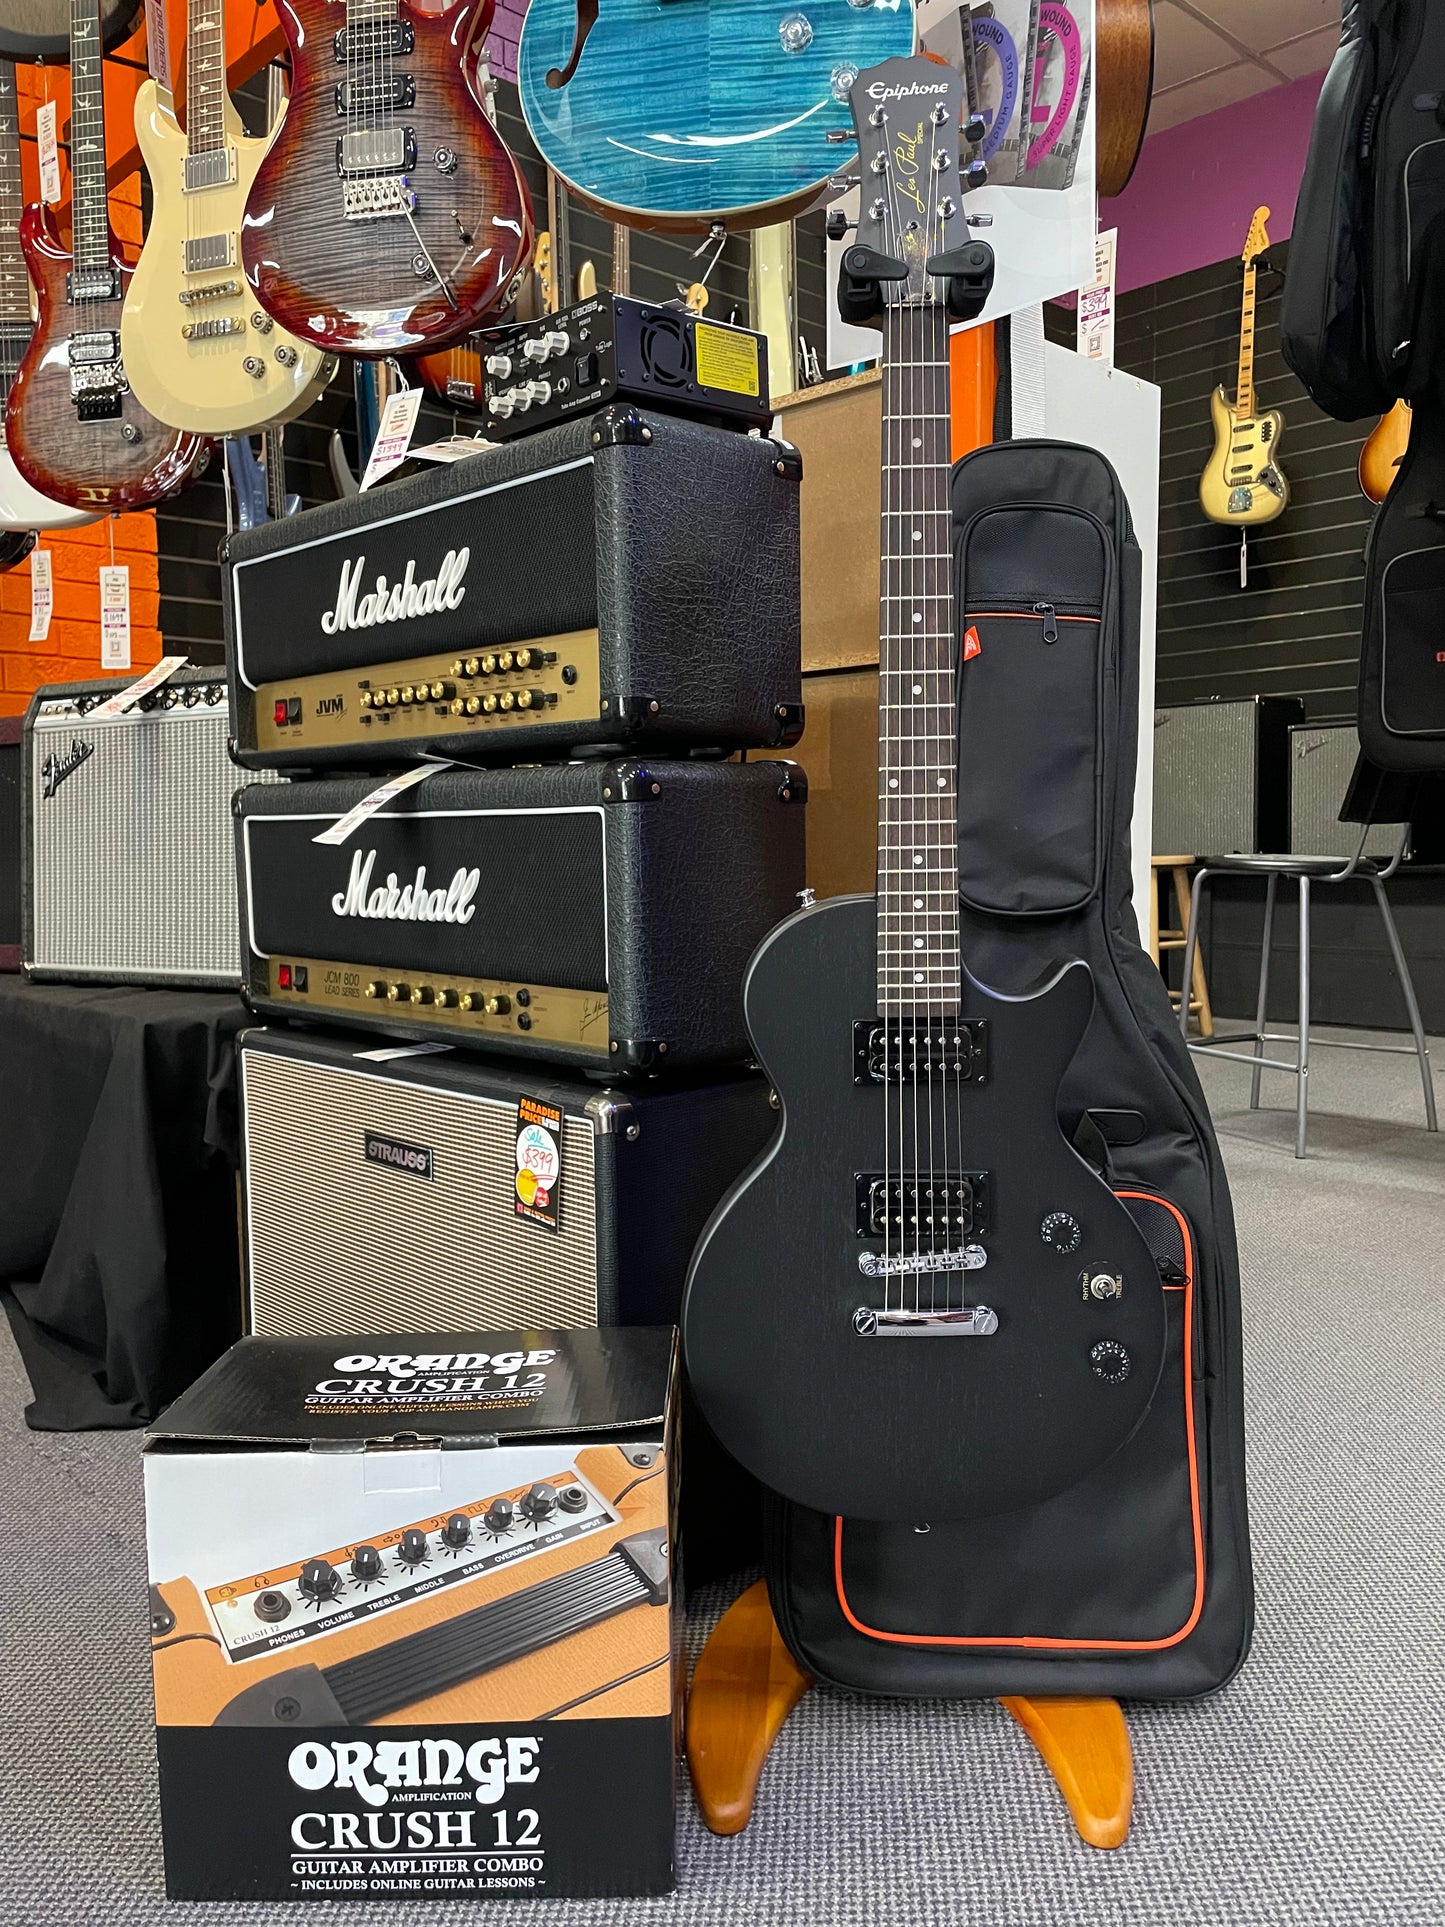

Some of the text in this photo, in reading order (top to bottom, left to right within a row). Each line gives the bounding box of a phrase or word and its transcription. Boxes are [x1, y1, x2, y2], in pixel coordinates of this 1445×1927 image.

[1040, 10, 1072, 37] WOUND
[1006, 53, 1014, 101] GAUGE
[865, 81, 949, 101] Epiphone
[1032, 44, 1077, 159] SUPER LIGHT GAUGE
[893, 131, 926, 214] Les Paul
[573, 300, 598, 318] BOSS
[320, 546, 470, 635] Marshall
[316, 698, 344, 715] JVM
[42, 739, 94, 800] Fender
[331, 849, 481, 925] Marshall
[323, 970, 341, 984] JCM
[343, 972, 360, 986] 800
[324, 984, 360, 998] LEAD SERIES
[519, 1108, 542, 1125] PRICE
[520, 1098, 560, 1121] PARADISE
[368, 1140, 427, 1171] STRAUSS
[522, 1147, 554, 1174] $399
[1082, 1272, 1090, 1301] RHYTHM
[1115, 1274, 1123, 1299] TREBLE
[333, 1349, 557, 1378] ORANGE
[417, 1369, 490, 1377] AMPLIFICATION
[315, 1372, 547, 1394] CRUSH 12
[375, 1393, 473, 1404] AMPLIFIER
[478, 1389, 544, 1400] COMBO
[268, 1518, 602, 1647] PHONES VOLUME TREBLE MIDDLE BASS OVERDRIVE GAIN INPUT
[233, 1625, 281, 1646] CRUSH 12
[288, 1736, 541, 1807] ORANGE
[391, 1791, 472, 1803] AMPLIFICATION
[290, 1808, 542, 1850] CRUSH 12
[292, 1857, 544, 1875] GUITAR AMPLIFIER COMBO
[301, 1877, 535, 1891] INCLUDES ONLINE GUITAR LESSONS
